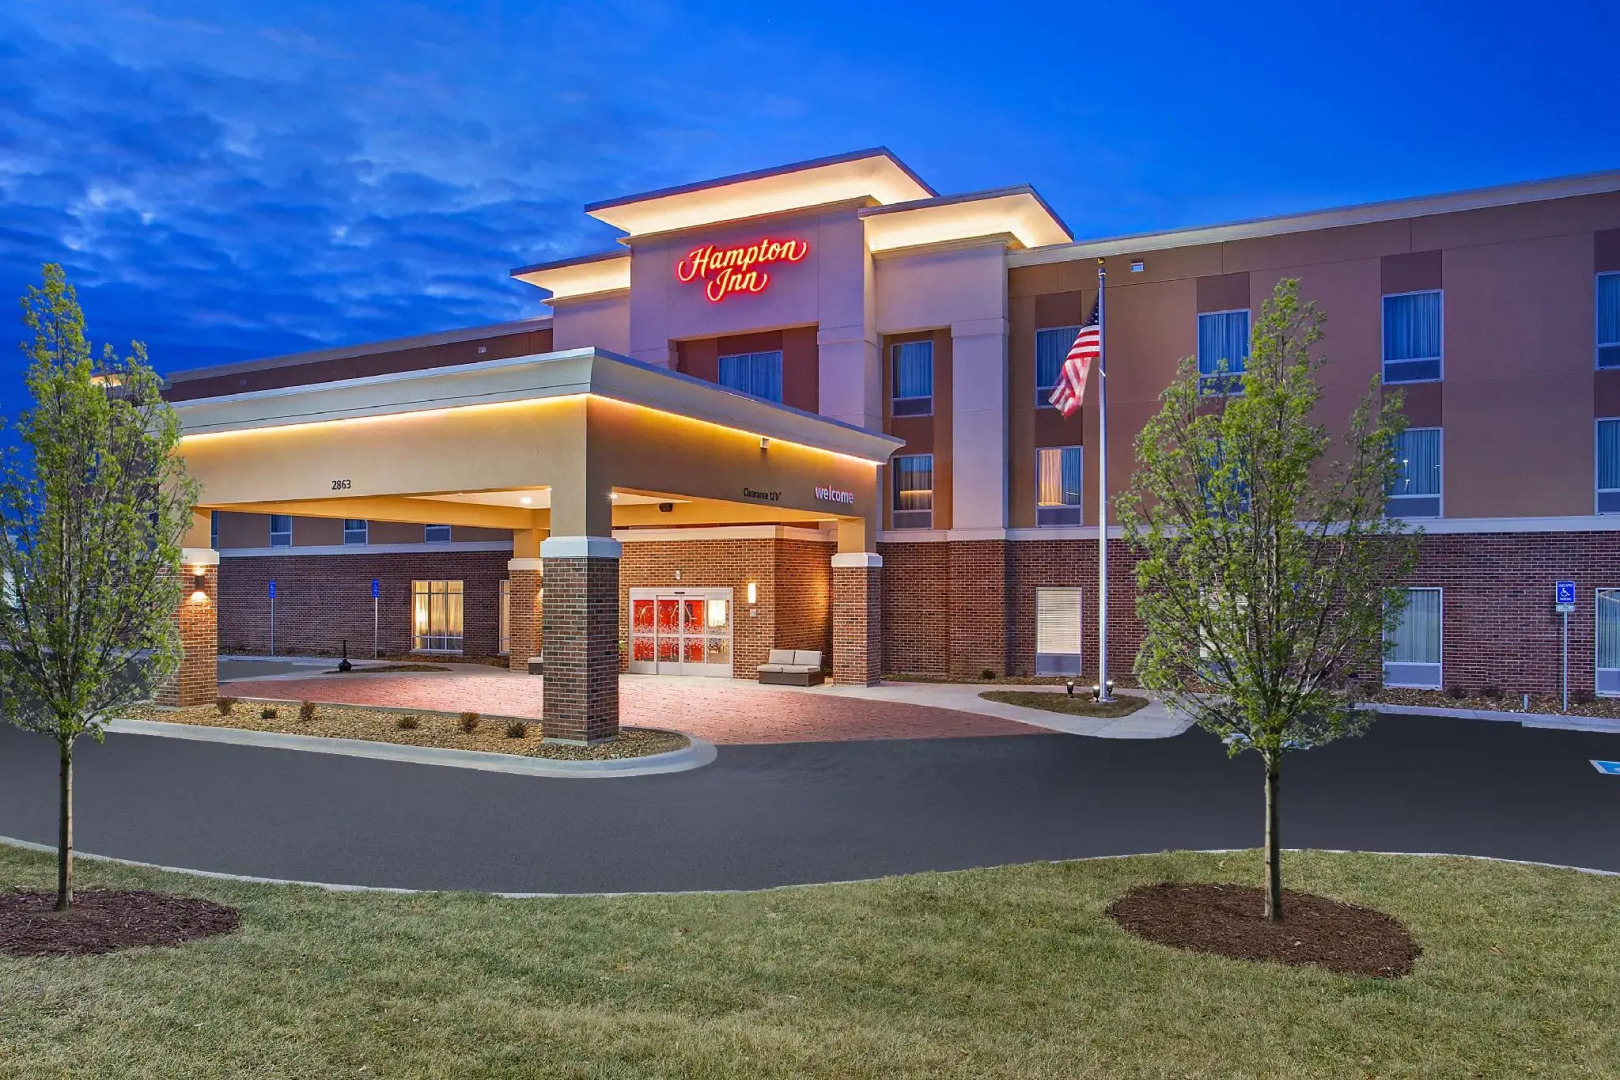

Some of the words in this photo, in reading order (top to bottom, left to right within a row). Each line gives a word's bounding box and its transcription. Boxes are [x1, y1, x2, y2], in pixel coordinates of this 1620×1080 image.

[678, 239, 807, 281] Hampton
[707, 268, 767, 301] Inn
[331, 479, 352, 490] 2863
[743, 487, 769, 500] Clearance
[815, 485, 854, 503] welcome
